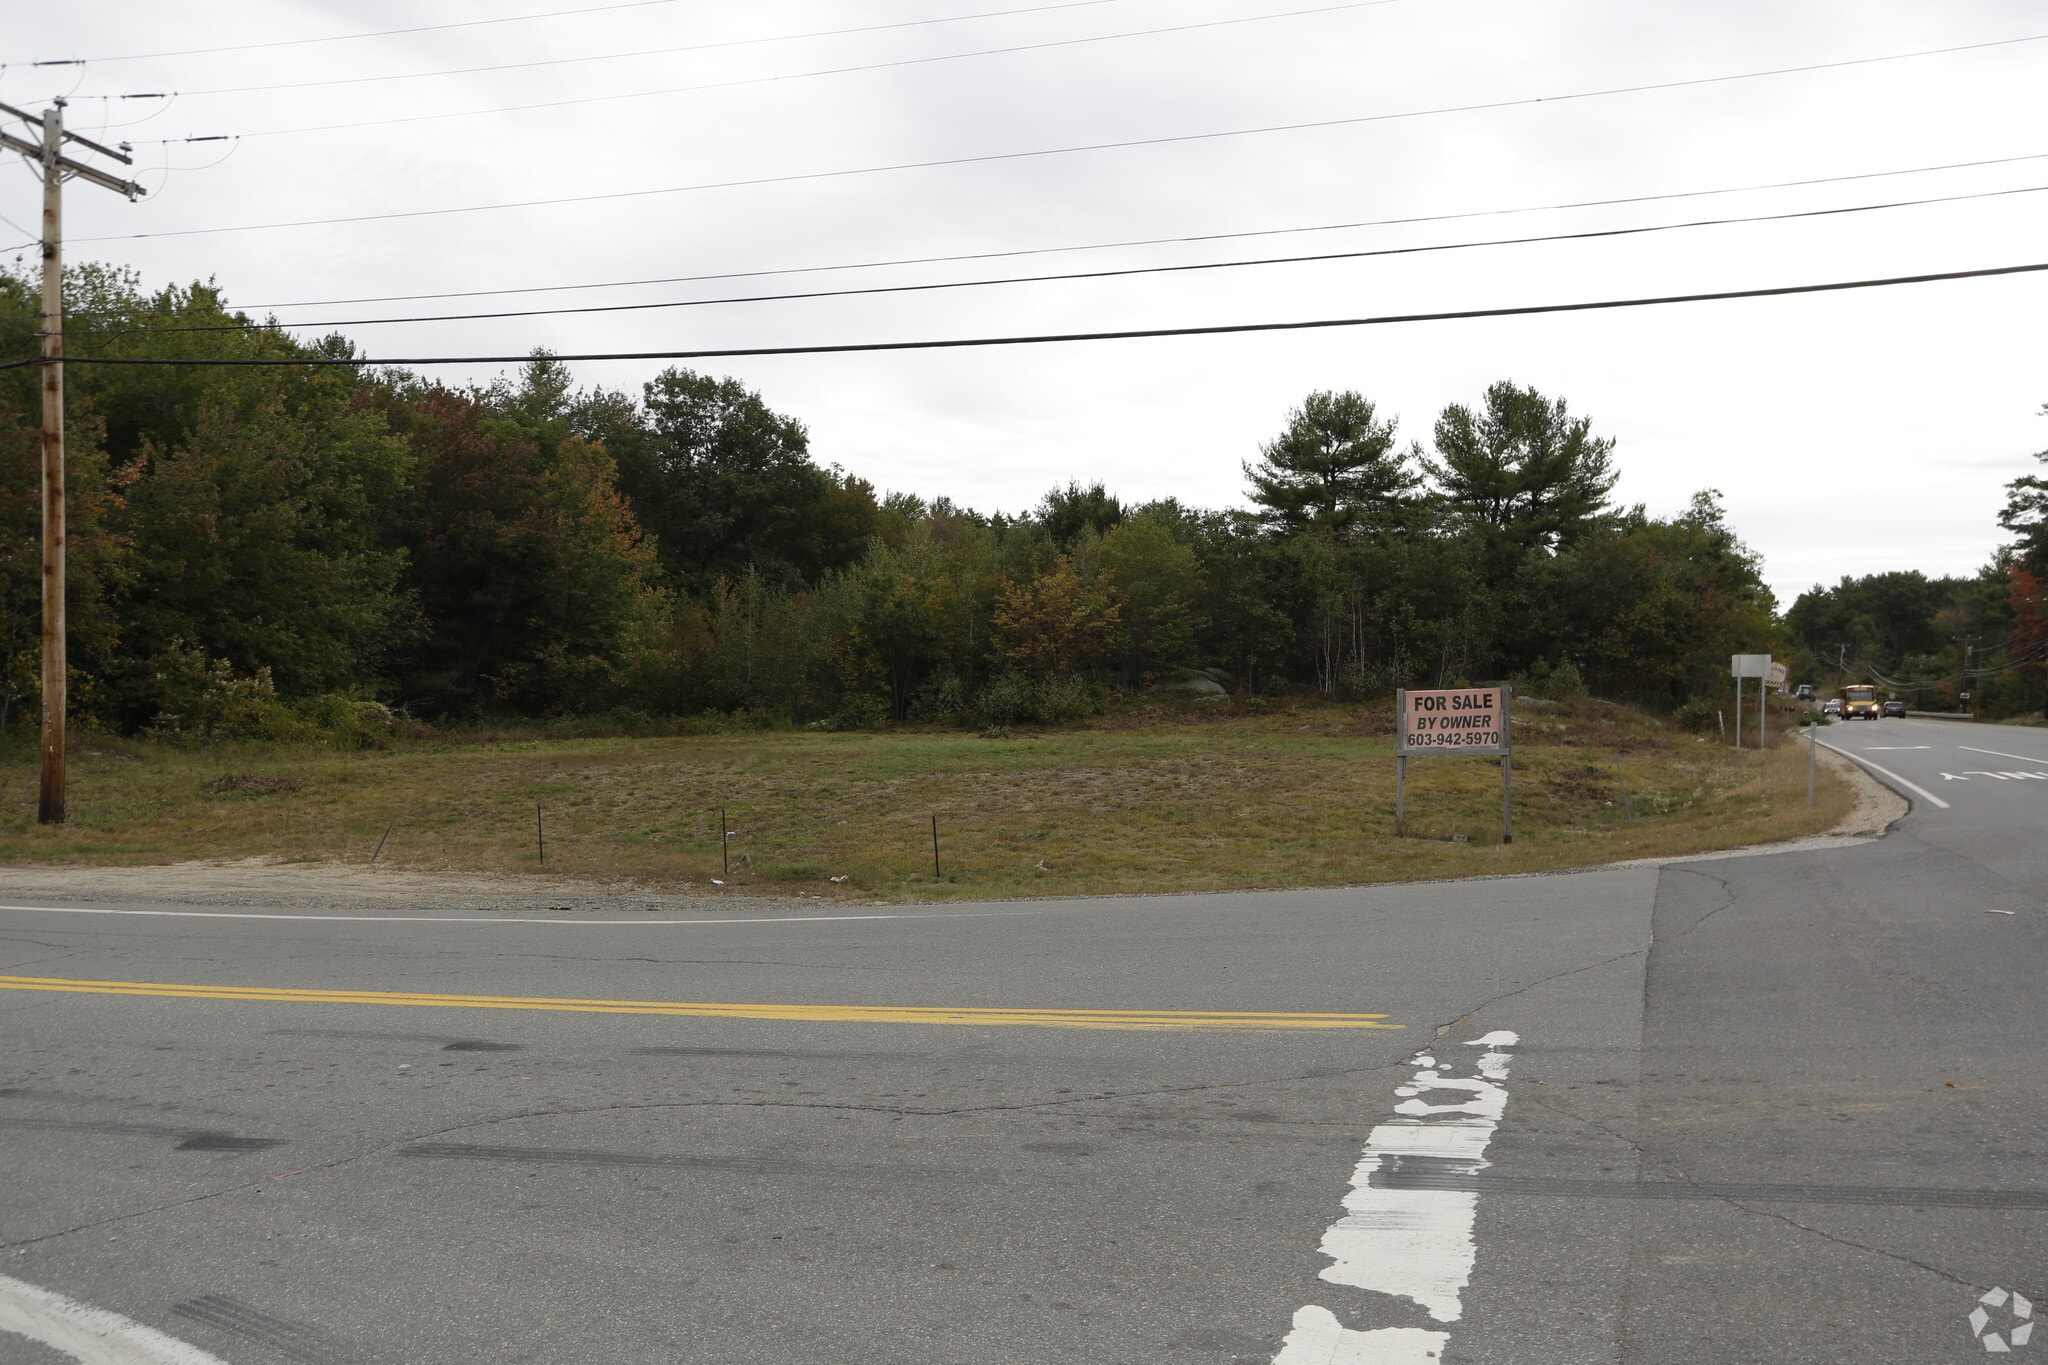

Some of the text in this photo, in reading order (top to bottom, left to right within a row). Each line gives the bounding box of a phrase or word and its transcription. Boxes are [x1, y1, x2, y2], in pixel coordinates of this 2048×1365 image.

[1414, 694, 1492, 711] FOR SALE
[1417, 715, 1491, 730] BY OWNER
[1408, 732, 1498, 745] 603-942-5970
